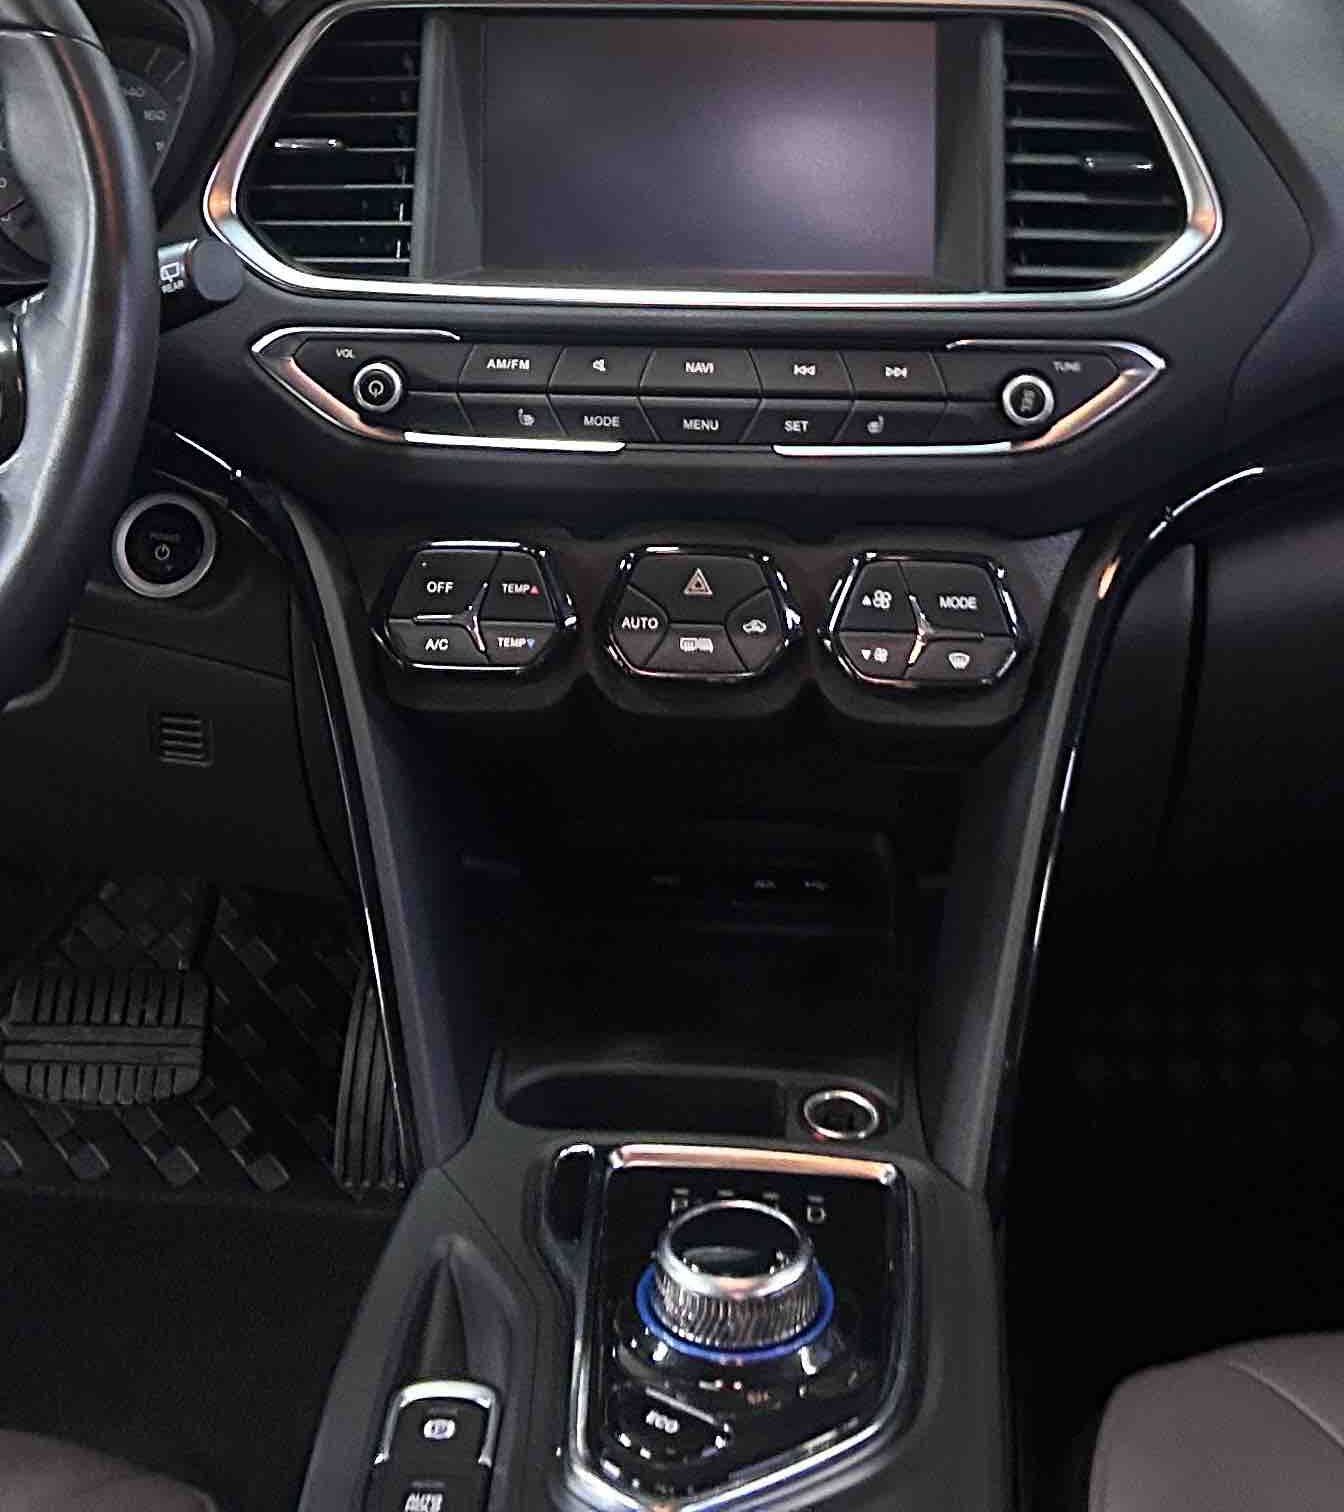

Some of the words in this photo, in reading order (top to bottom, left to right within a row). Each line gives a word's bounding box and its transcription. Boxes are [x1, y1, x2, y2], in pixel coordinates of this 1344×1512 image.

[336, 347, 356, 360] VOL
[486, 358, 531, 372] AM/FM
[684, 361, 715, 374] NAVI
[583, 414, 621, 429] MODE
[682, 418, 720, 432] MENU
[783, 419, 810, 434] SET
[426, 580, 455, 594] OFF
[501, 583, 531, 594] TEMP
[938, 595, 978, 611] MODE
[620, 615, 659, 631] AUTO
[425, 637, 449, 652] A/C
[496, 637, 527, 649] TEMP
